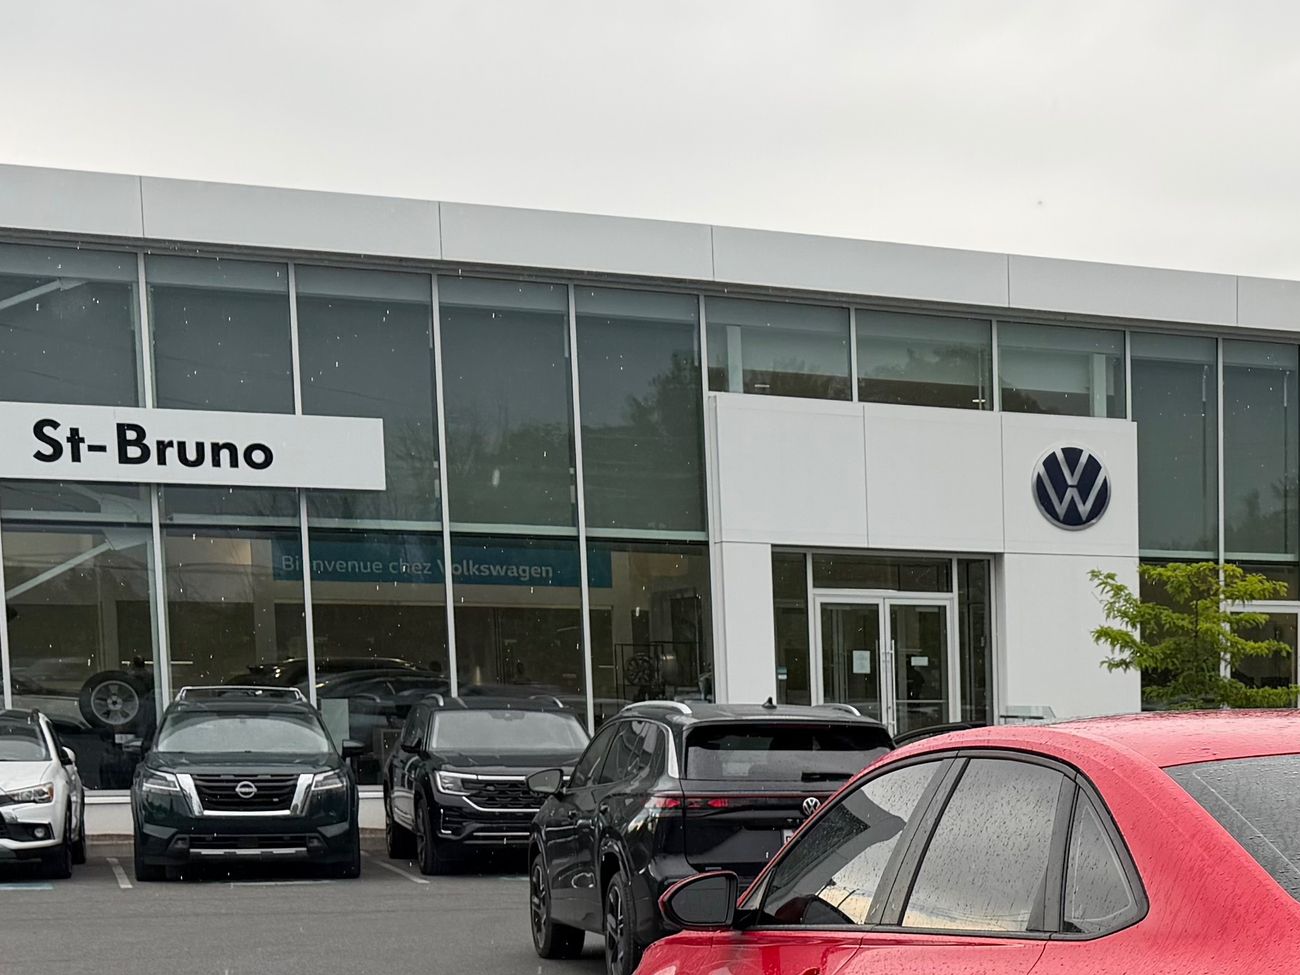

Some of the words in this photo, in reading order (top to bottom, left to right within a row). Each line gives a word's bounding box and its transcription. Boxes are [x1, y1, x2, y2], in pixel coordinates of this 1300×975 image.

[33, 418, 273, 470] St-Bruno
[1033, 445, 1109, 525] VW
[282, 555, 382, 573] Binvenue
[389, 558, 432, 575] chez
